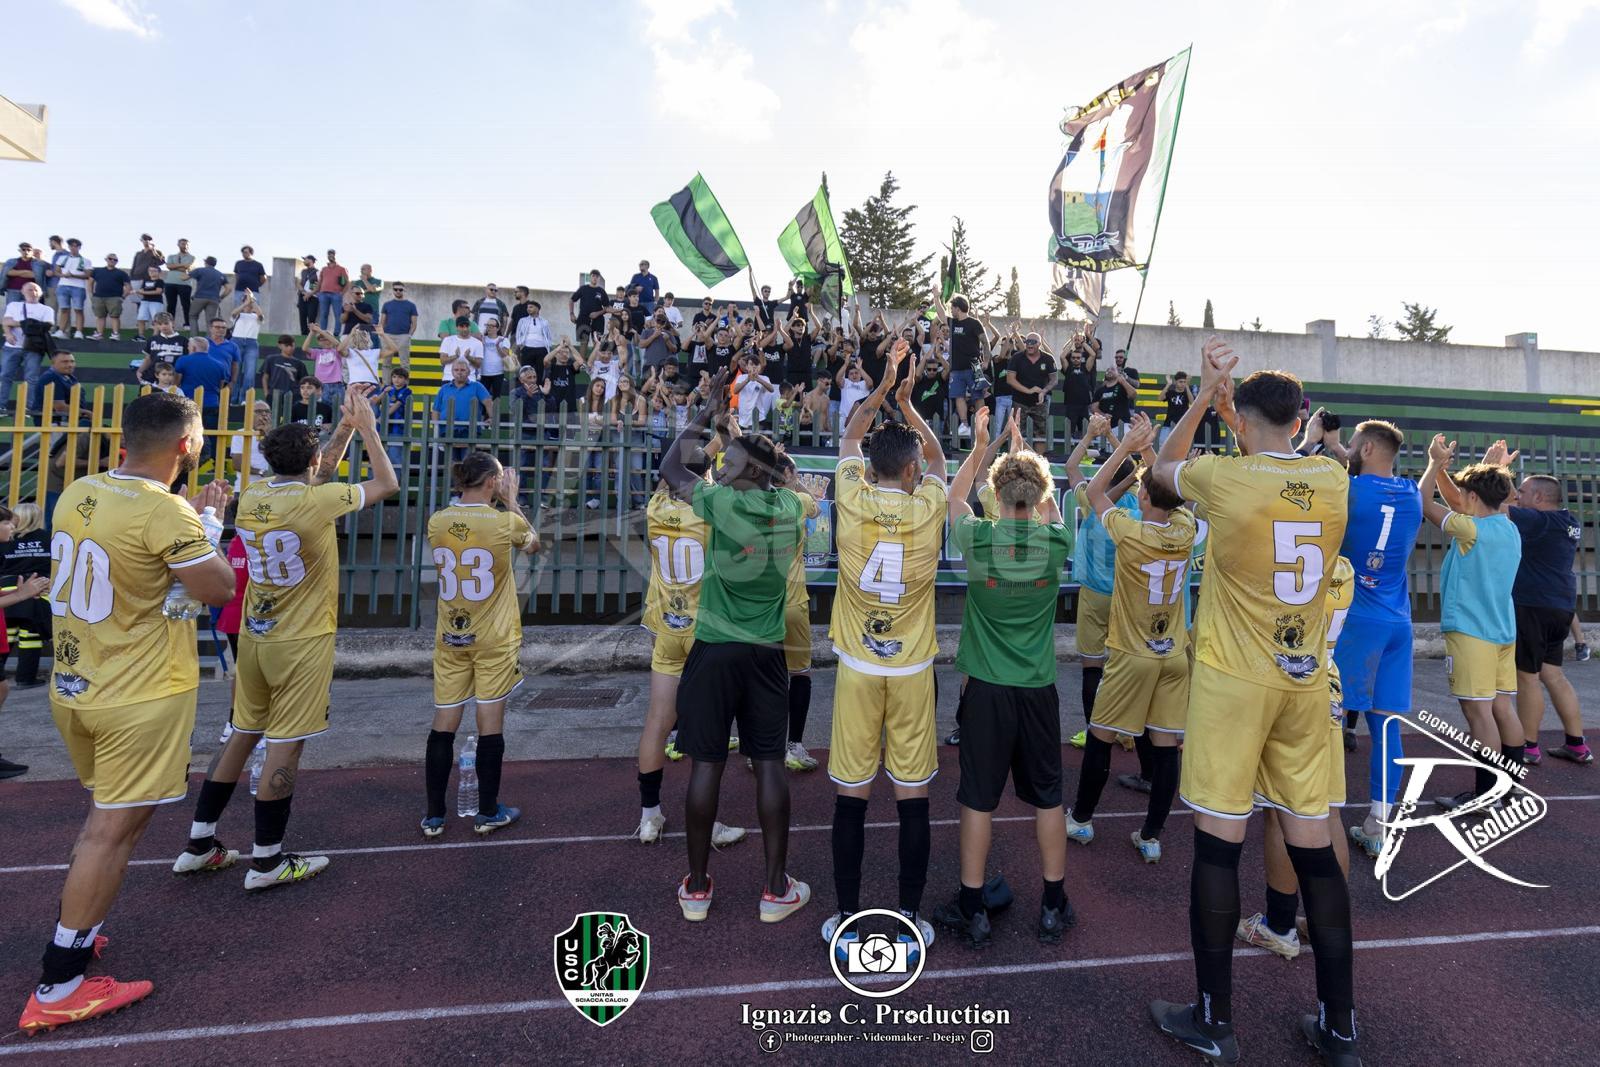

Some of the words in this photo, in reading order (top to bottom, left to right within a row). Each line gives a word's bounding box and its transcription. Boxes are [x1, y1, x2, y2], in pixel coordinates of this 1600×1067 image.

[1286, 480, 1309, 490] Isola
[1375, 504, 1396, 551] 1
[50, 530, 114, 625] 20
[432, 546, 495, 602] 33
[651, 534, 705, 585] 10
[858, 540, 906, 604] 4
[1272, 520, 1325, 606] 5
